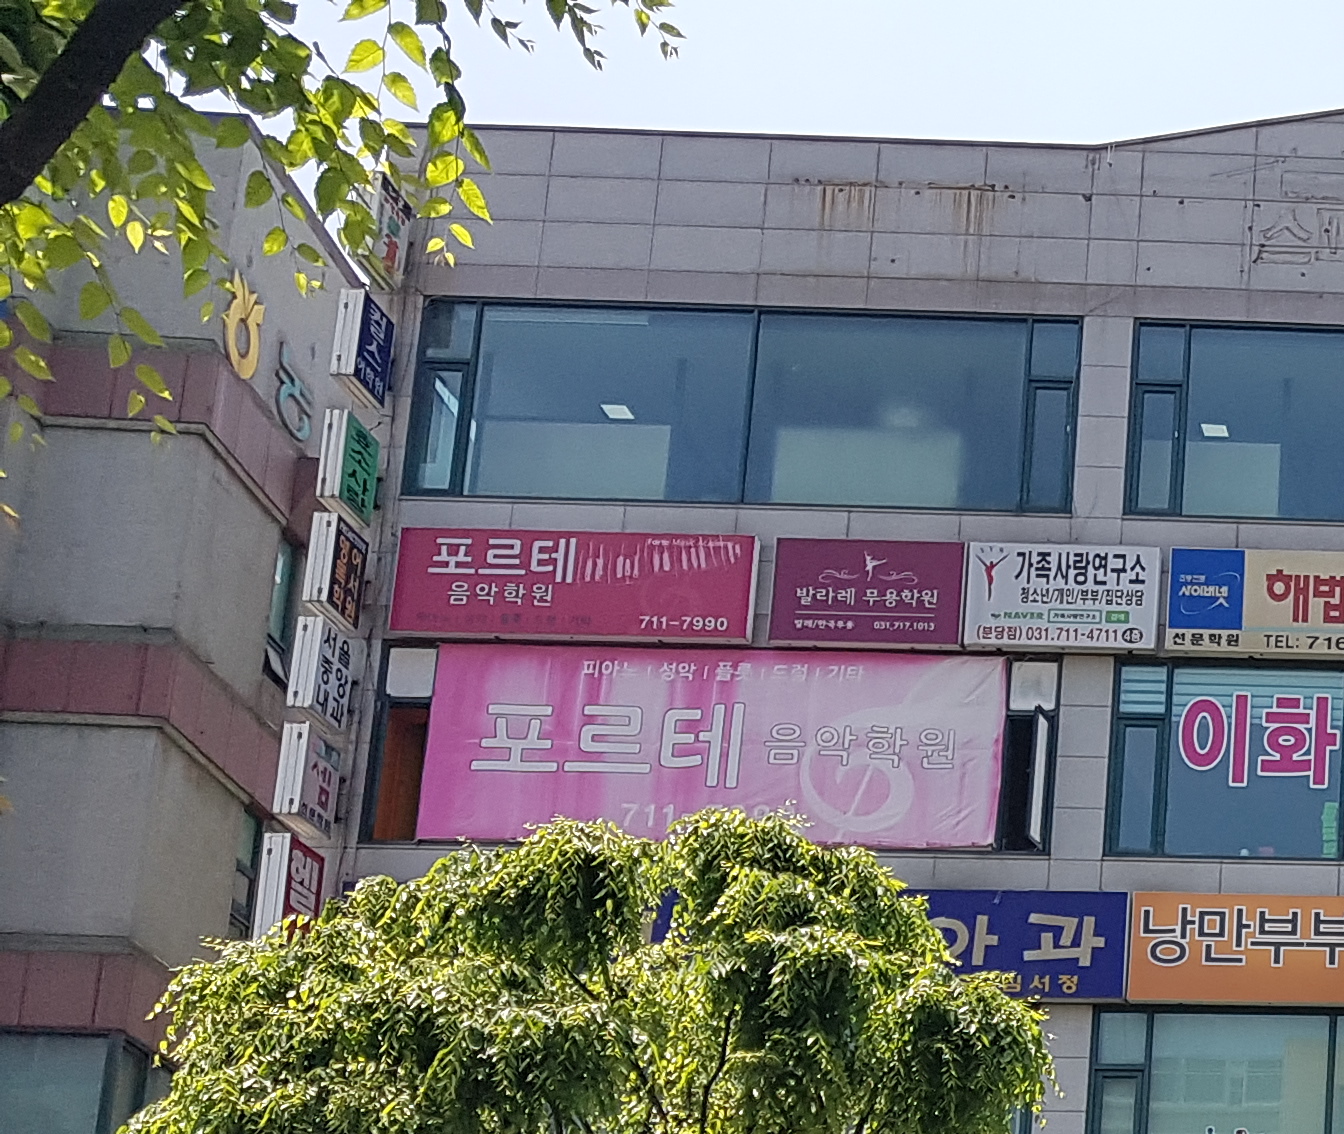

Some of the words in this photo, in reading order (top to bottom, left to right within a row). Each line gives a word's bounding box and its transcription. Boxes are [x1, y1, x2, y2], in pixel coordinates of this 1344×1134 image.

[427, 537, 577, 583] 포르테
[1014, 550, 1147, 586] 가족사랑연구소
[447, 582, 553, 607] 음악학원
[796, 586, 855, 606] 발라레
[862, 588, 938, 608] 무용학원
[1019, 588, 1144, 608] 청소년/개인/부부/집단상담
[639, 615, 728, 631] 711-7990
[1003, 610, 1044, 620] NAVER
[976, 625, 1022, 642] (분당점)
[1025, 626, 1118, 643] 031.711-4711
[1264, 635, 1300, 649] TEL:
[659, 661, 697, 681] 성악
[827, 664, 864, 682] 기타
[469, 701, 746, 789] 포르테
[762, 722, 957, 770] 음악학원
[1178, 692, 1339, 789] 이화
